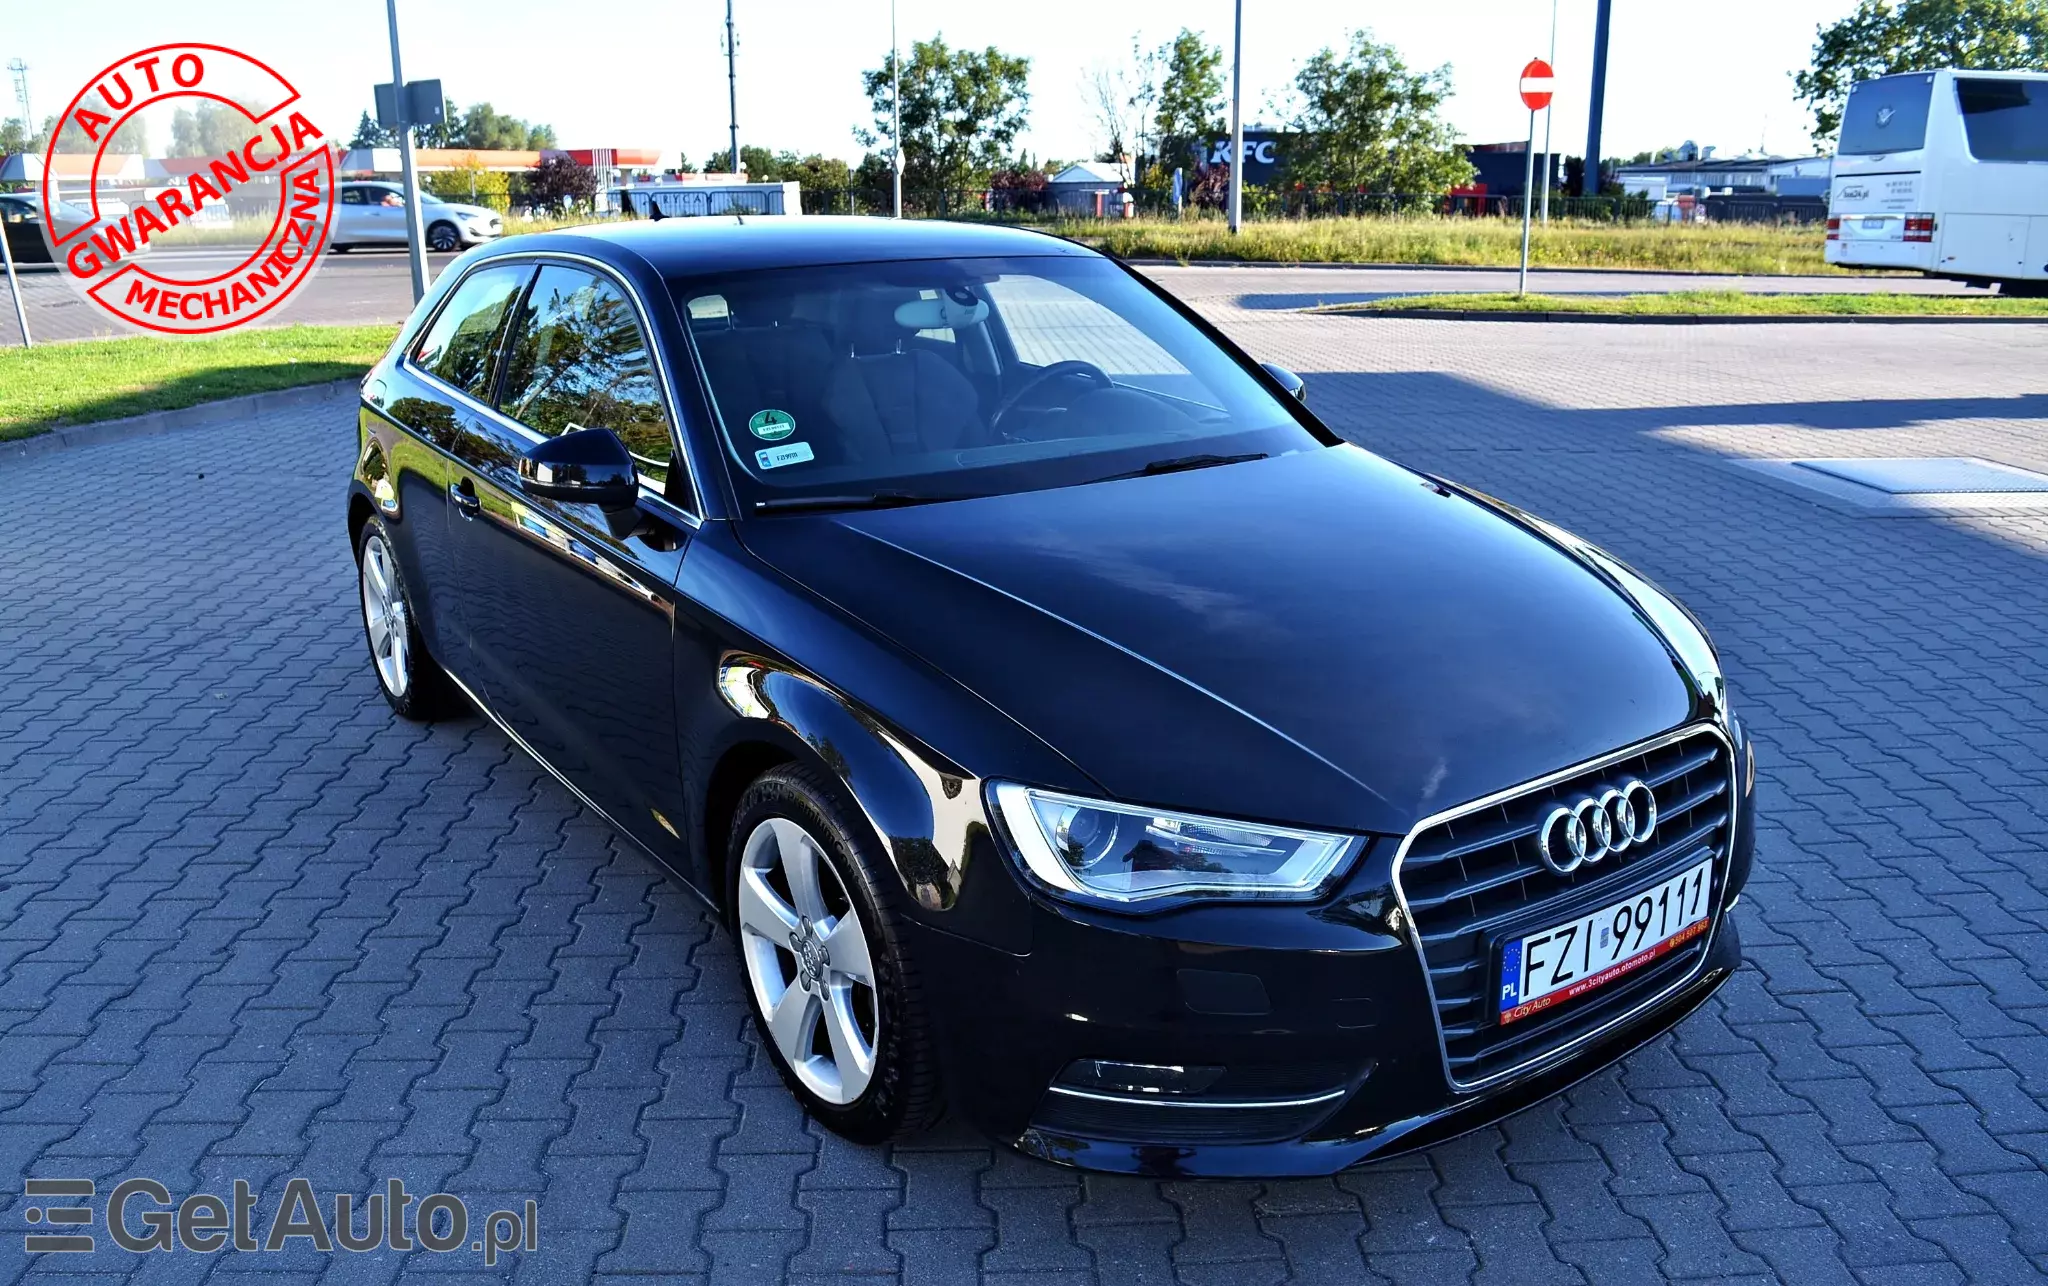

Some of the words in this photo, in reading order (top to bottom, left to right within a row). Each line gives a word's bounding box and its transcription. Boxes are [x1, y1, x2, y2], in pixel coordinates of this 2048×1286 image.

[1210, 141, 1276, 164] KFC
[1523, 919, 1594, 997] FZI
[1611, 867, 1704, 961] 99111
[1568, 948, 1656, 996] www.3cityauto.otomoto.pl
[1502, 982, 1518, 1000] PL
[1531, 997, 1551, 1011] Auto
